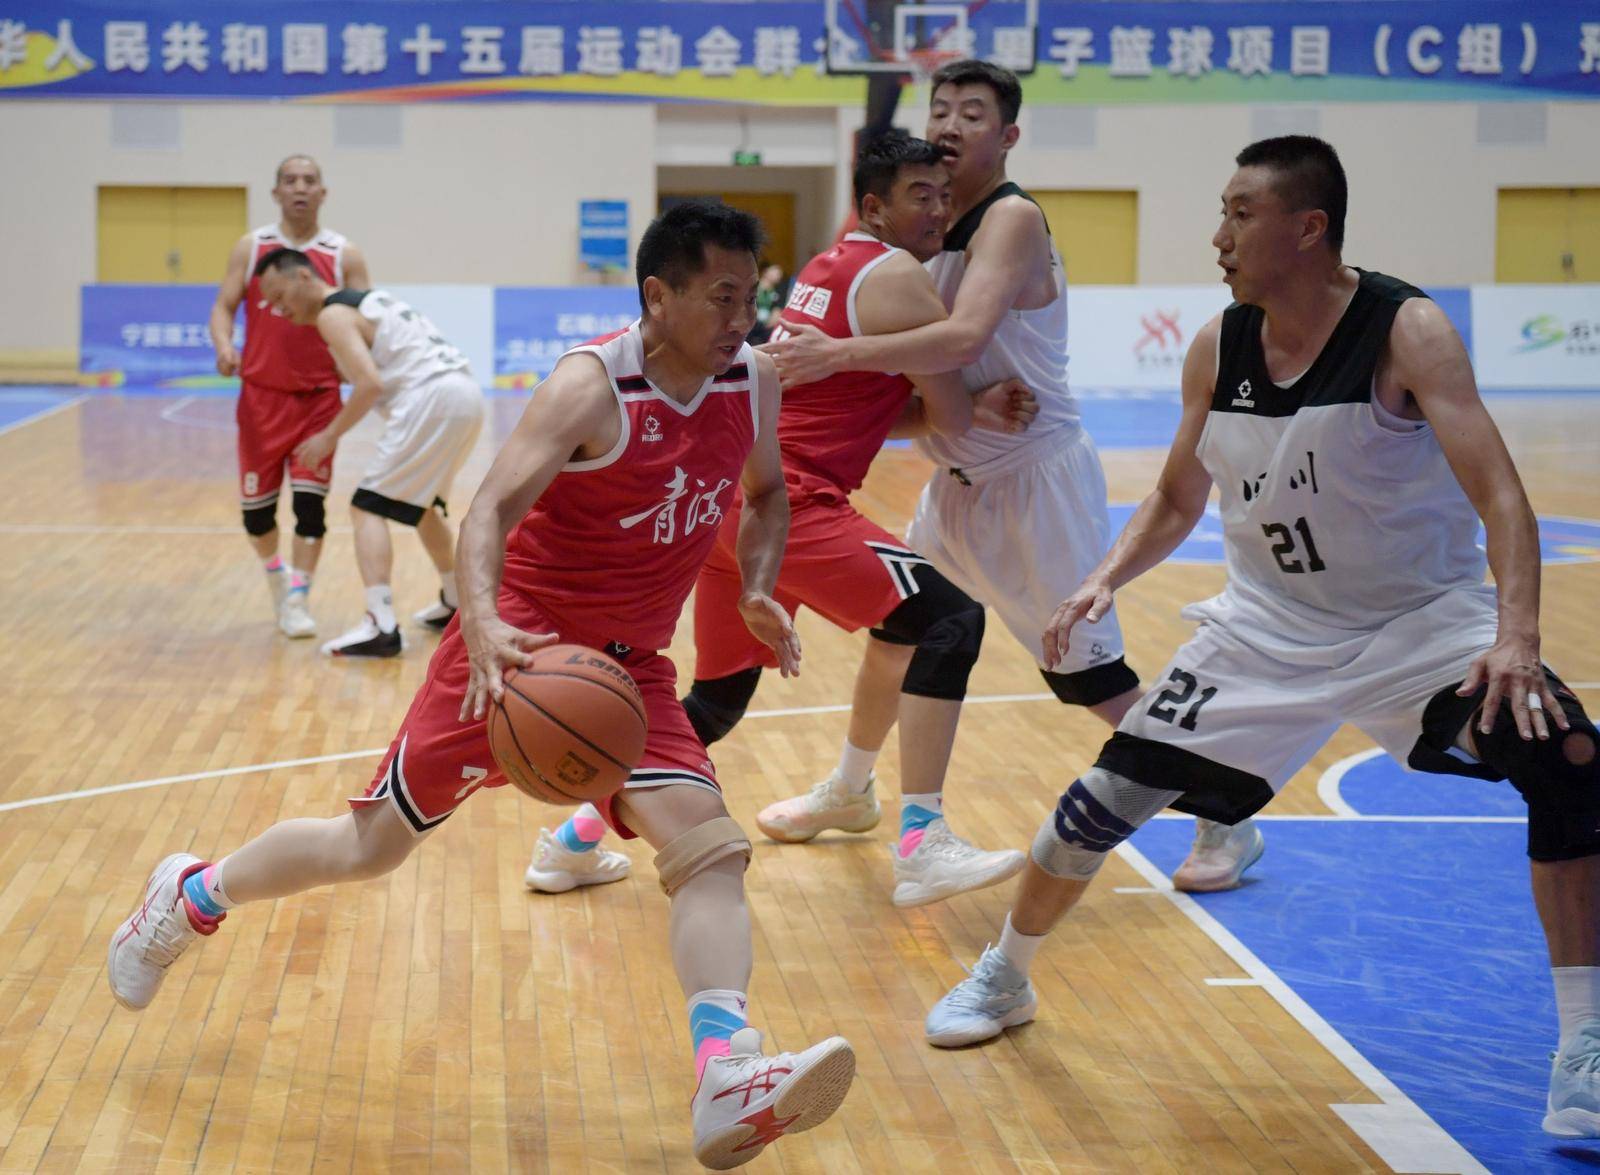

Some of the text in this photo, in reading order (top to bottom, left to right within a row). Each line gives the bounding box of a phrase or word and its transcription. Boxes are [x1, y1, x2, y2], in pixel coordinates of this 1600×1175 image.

[619, 465, 732, 544] 青海
[1261, 516, 1327, 574] 21
[1146, 667, 1218, 732] 21
[454, 765, 488, 799] 7
